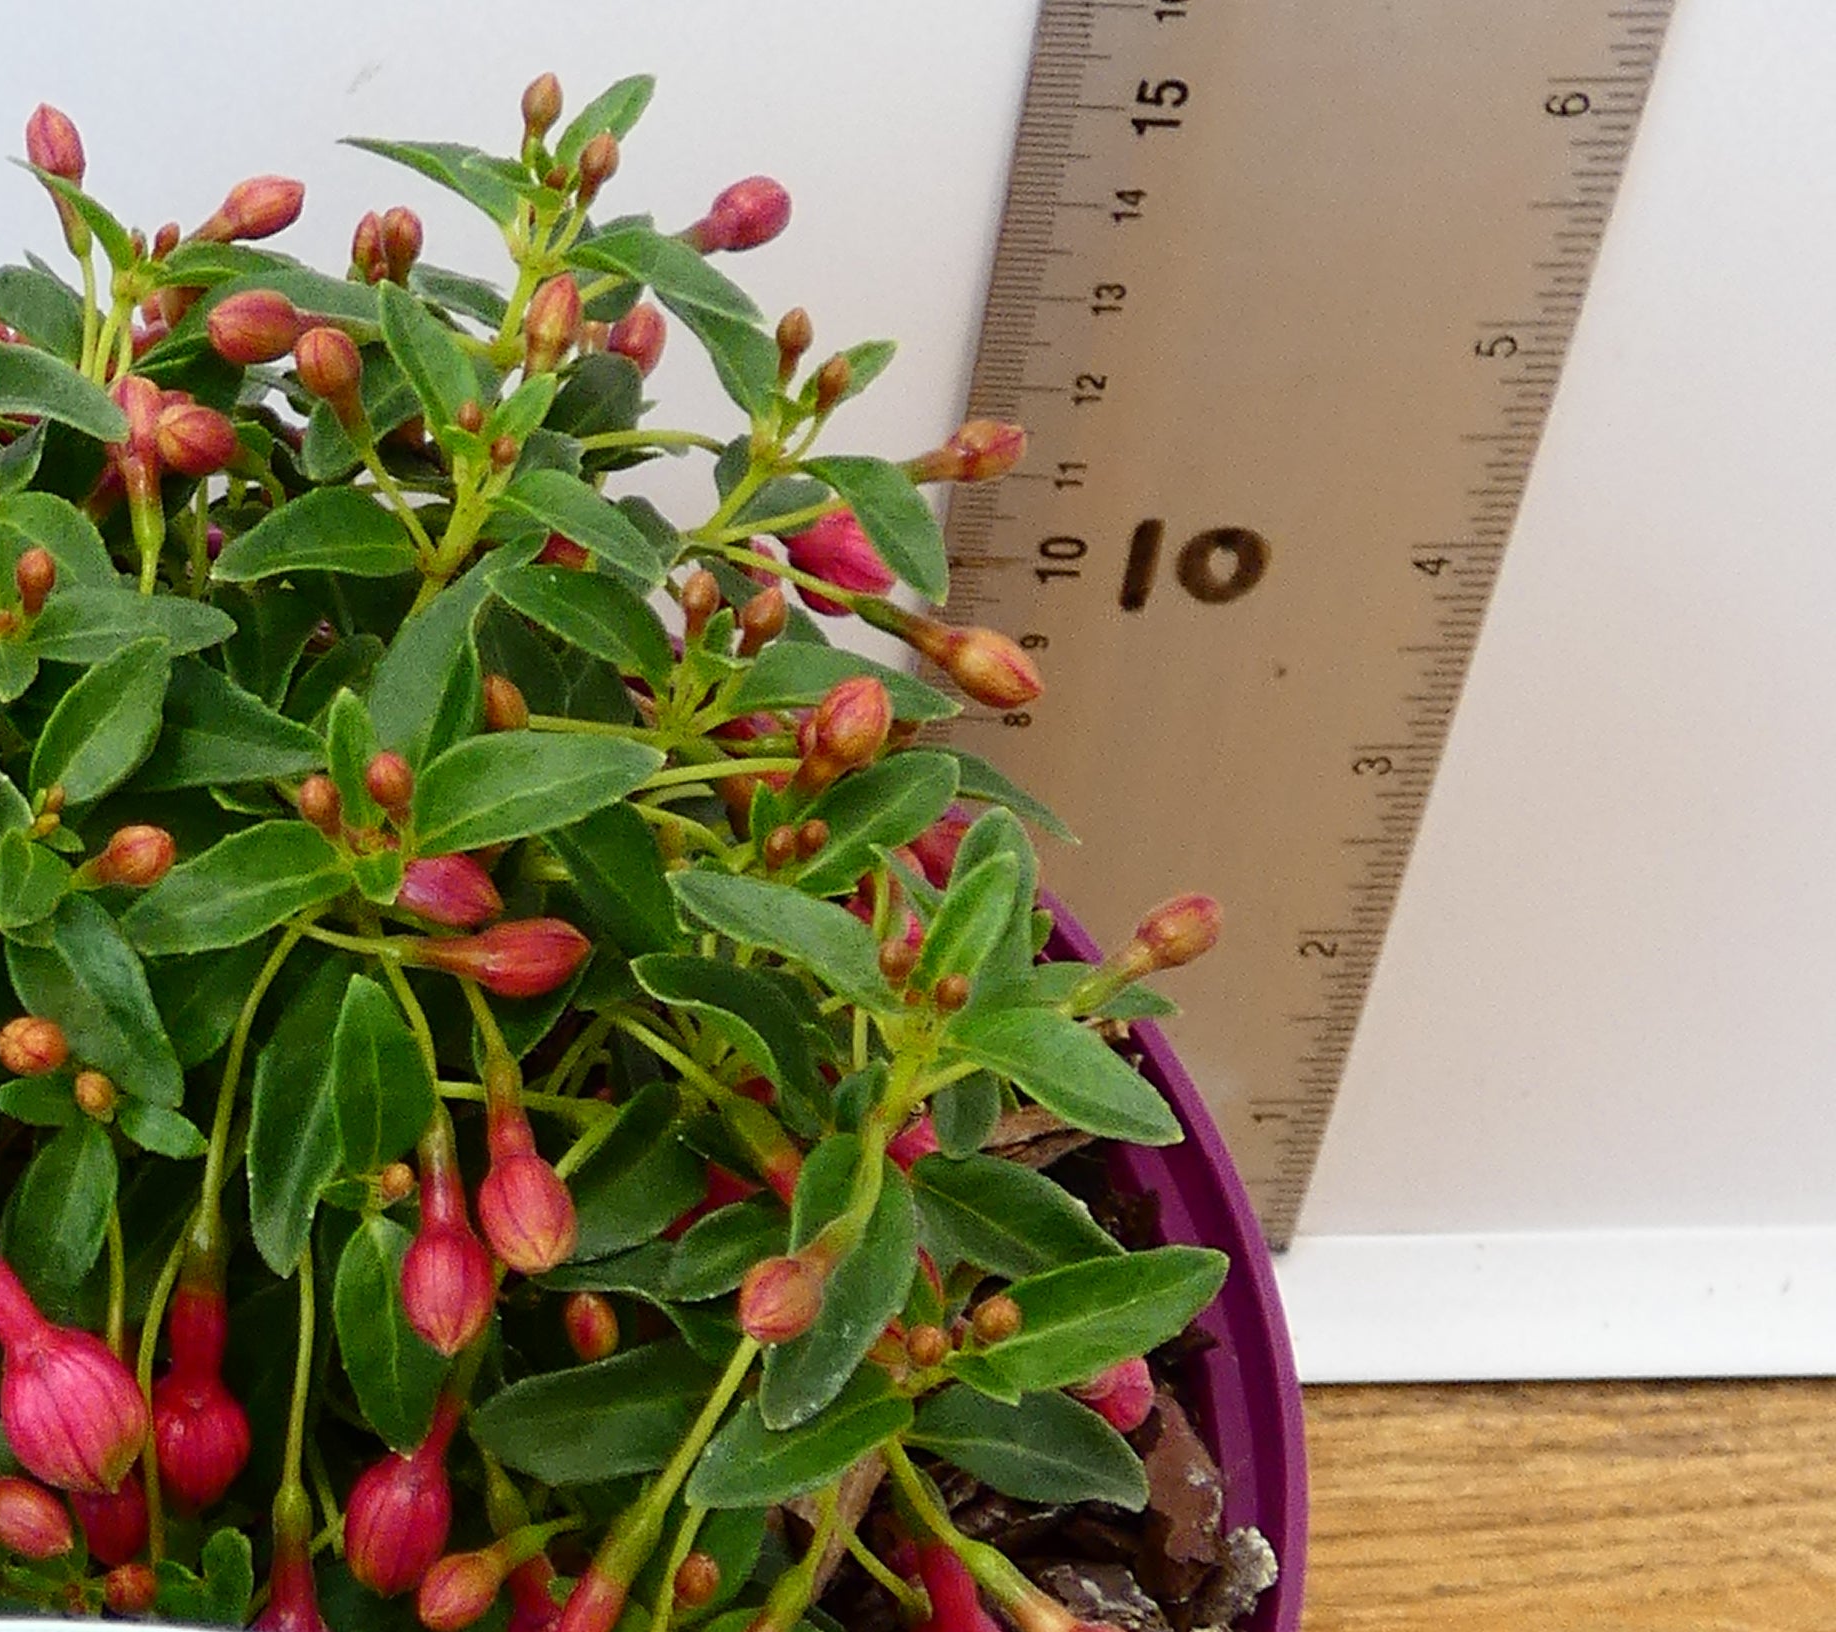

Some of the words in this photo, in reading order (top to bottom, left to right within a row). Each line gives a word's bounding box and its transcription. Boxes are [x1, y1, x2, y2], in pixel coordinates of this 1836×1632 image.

[1130, 78, 1190, 137] 15
[1545, 92, 1590, 117] 6
[1110, 188, 1148, 224] 14
[1091, 282, 1128, 317] 13
[1475, 334, 1518, 358] 5
[1071, 372, 1108, 407] 12
[1053, 461, 1088, 489] 11
[1035, 535, 1088, 584] 10
[1118, 518, 1271, 612] 10
[1413, 556, 1452, 578] 4
[1020, 633, 1050, 650] 9
[1003, 712, 1032, 728] 8
[1352, 754, 1394, 776] 3
[1298, 939, 1338, 958] 2
[1251, 1112, 1288, 1123] 1
